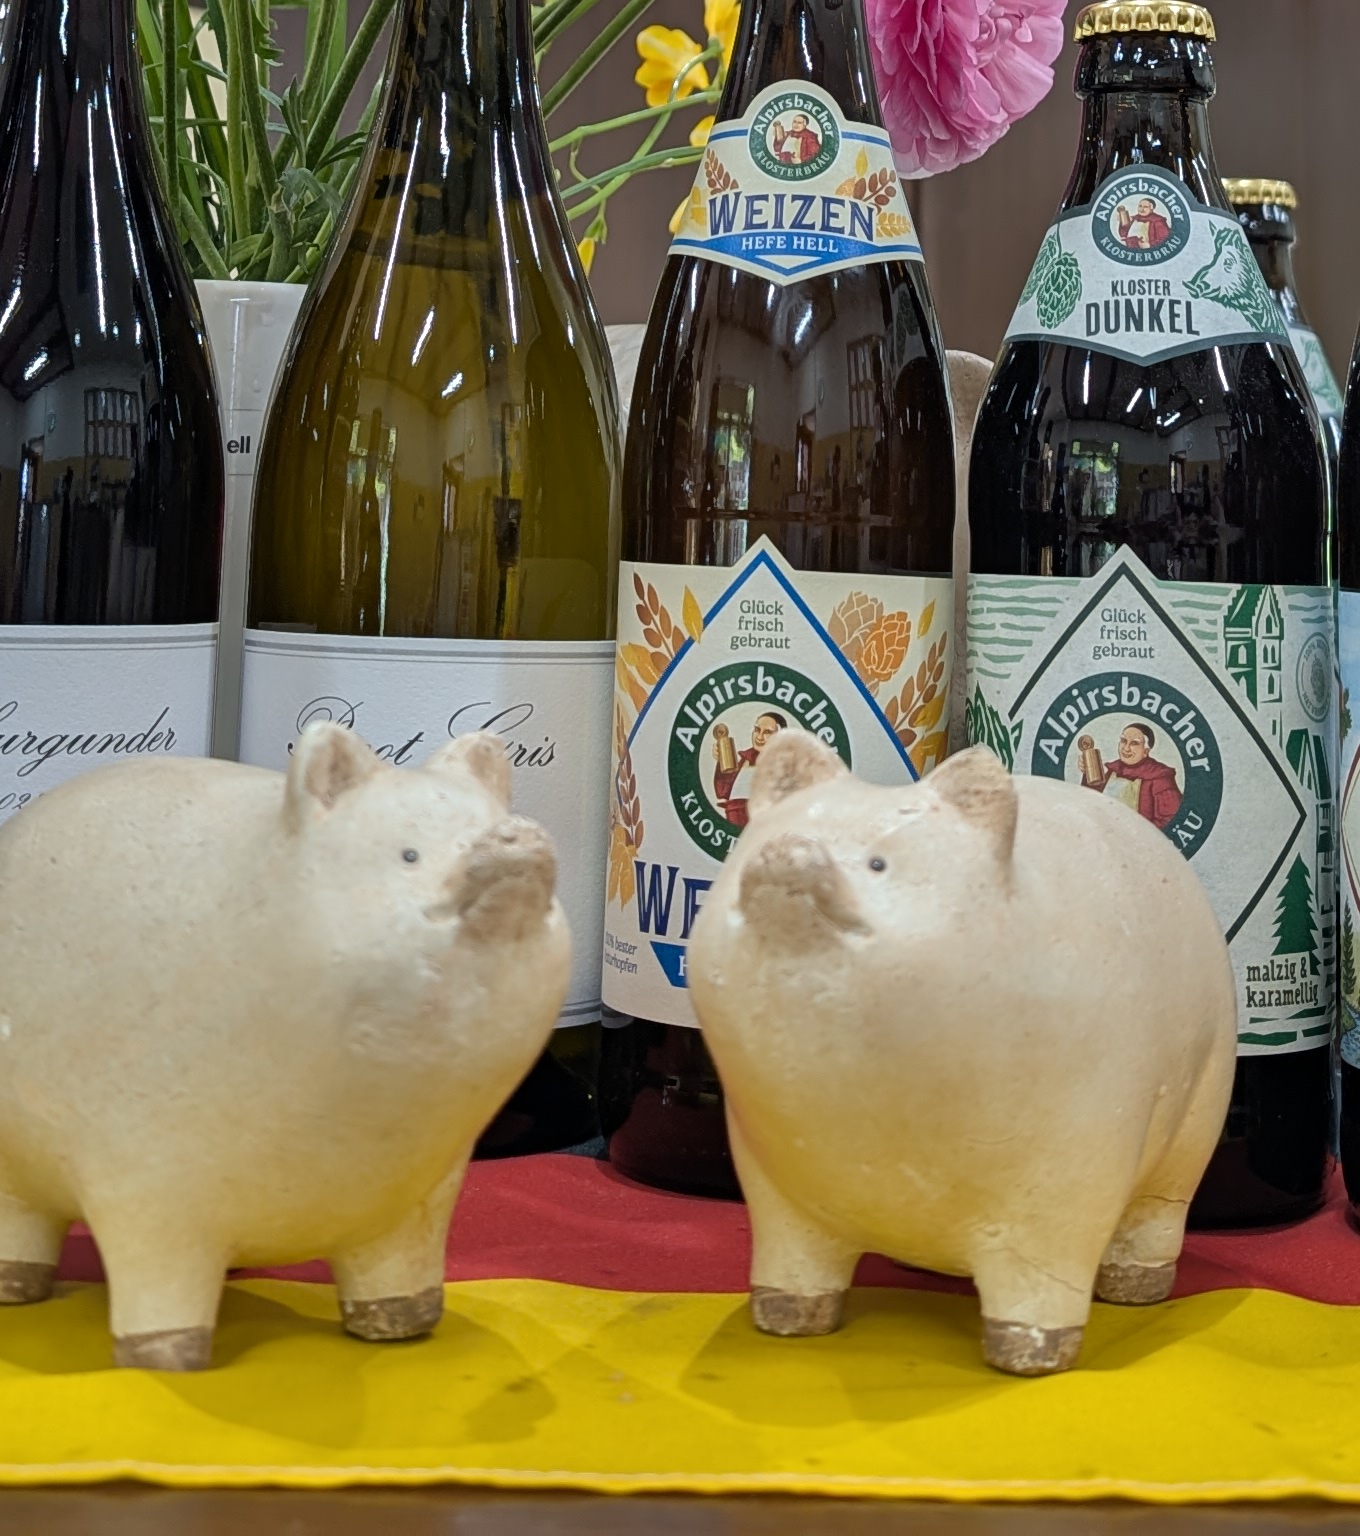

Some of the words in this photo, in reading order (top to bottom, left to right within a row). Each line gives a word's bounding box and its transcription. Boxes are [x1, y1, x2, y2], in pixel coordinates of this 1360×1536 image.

[753, 94, 835, 137] Alpirsbacher
[756, 150, 831, 178] KLOSTERBRÄU
[1096, 179, 1185, 222] Alpirsbacher
[709, 192, 875, 242] WEIZEN
[741, 235, 787, 251] HEFE
[792, 236, 839, 254] HELL
[1101, 235, 1182, 262] KLOSTERBRÄU
[1111, 279, 1171, 297] KLOSTER
[1086, 299, 1200, 337] DUNKEL
[227, 436, 251, 455] ell
[739, 599, 785, 616] Glück
[1100, 607, 1147, 625] Glück
[737, 616, 784, 633] frisch
[1099, 625, 1147, 642] frisch
[730, 633, 791, 652] gebraut
[1092, 642, 1155, 661] gebraut
[1040, 677, 1212, 773] Alpirsbacher
[1246, 958, 1297, 984] malzig
[1301, 956, 1307, 978] &
[1245, 980, 1319, 1008] karamellig
